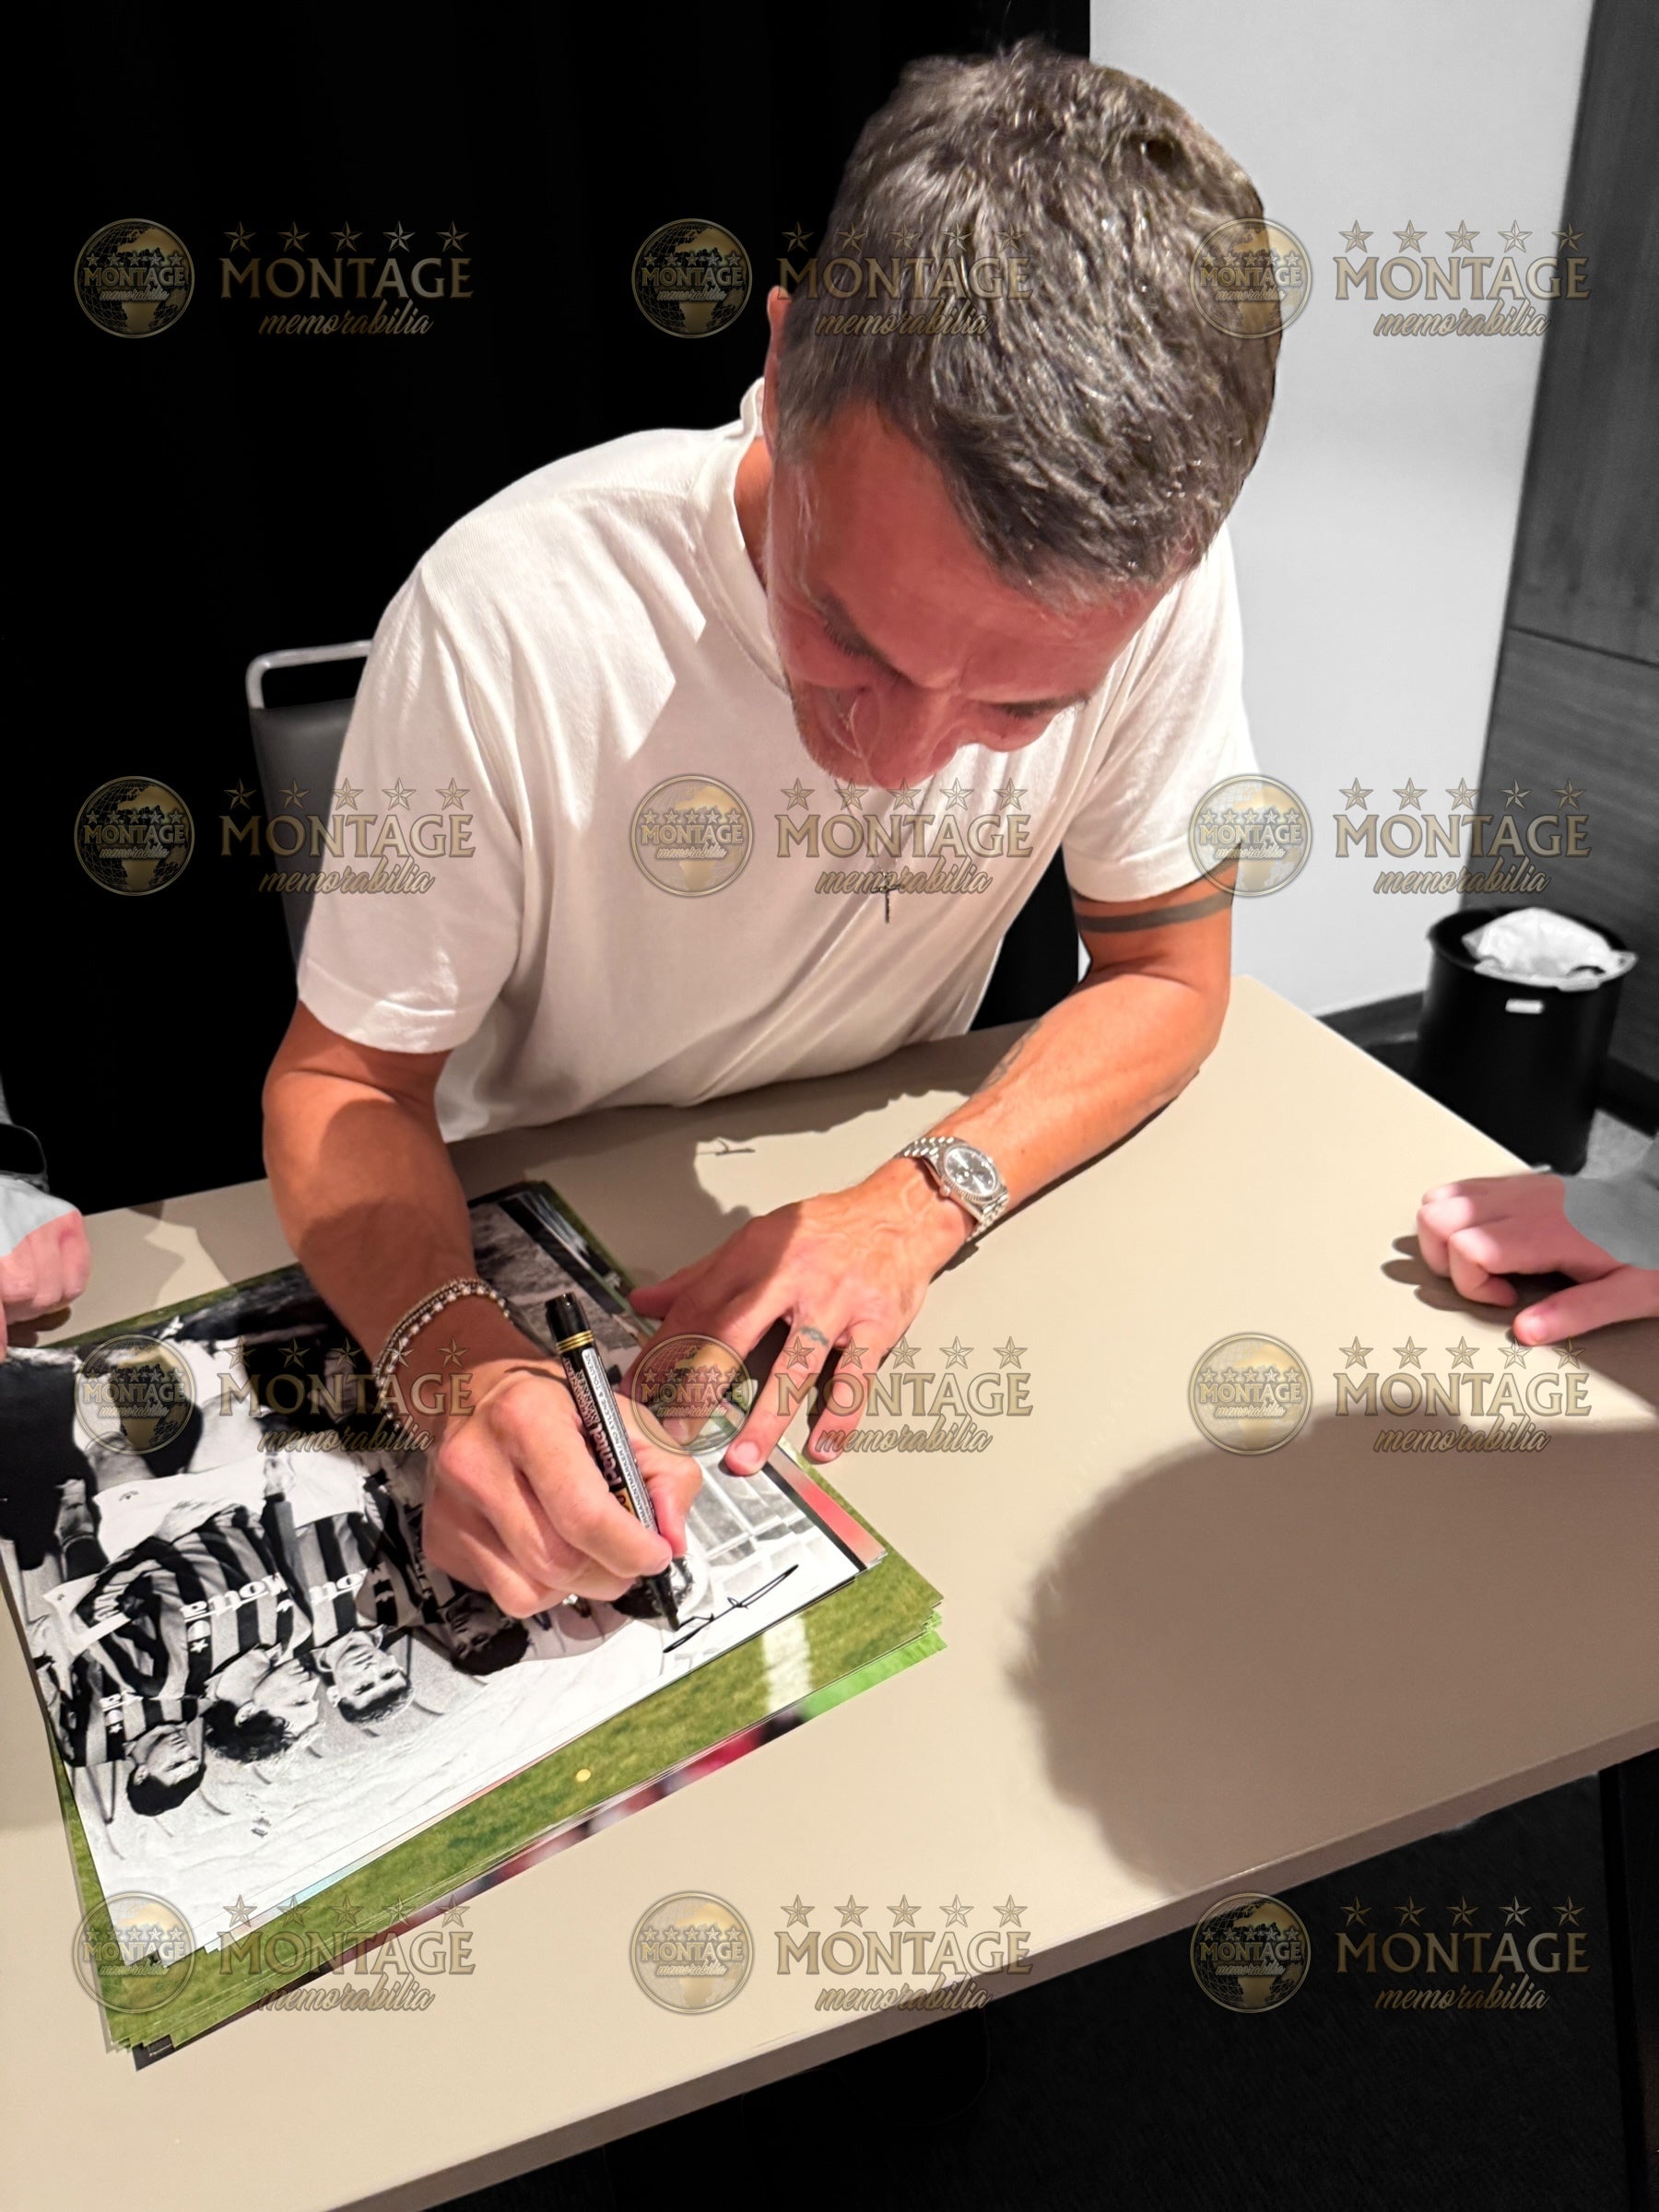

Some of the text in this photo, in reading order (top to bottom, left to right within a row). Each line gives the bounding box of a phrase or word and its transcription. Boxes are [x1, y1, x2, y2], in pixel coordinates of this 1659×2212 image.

[588, 1422, 623, 1487] Pentel
[618, 1449, 651, 1529] ERMANENTMARKER
[180, 1571, 288, 1623] Motta
